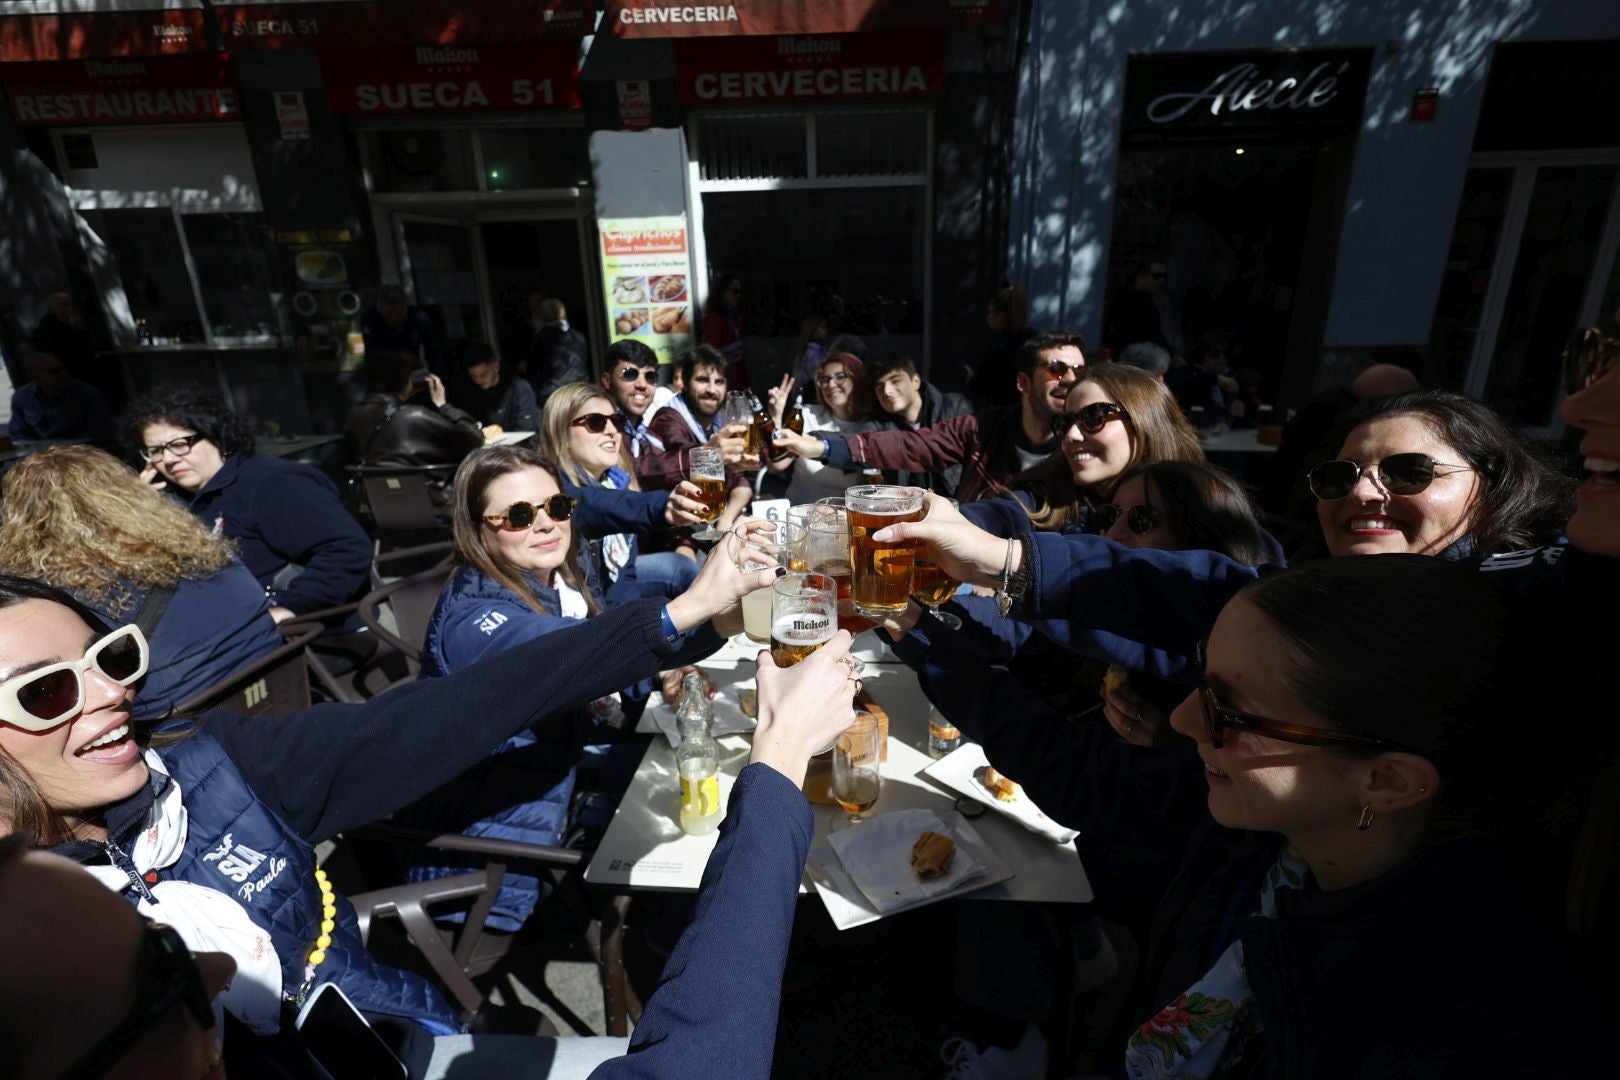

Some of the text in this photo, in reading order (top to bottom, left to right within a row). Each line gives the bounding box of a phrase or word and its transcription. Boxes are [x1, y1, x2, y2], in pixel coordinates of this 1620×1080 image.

[619, 5, 738, 25] CERVECERIA
[232, 19, 319, 37] SUECA 51
[415, 46, 480, 66] Mahou
[777, 37, 844, 55] Mahou
[694, 65, 928, 99] CERVECERIA
[15, 87, 237, 121] RESTAURANTE
[355, 78, 556, 111] SUECA 51
[766, 506, 779, 521] 6
[793, 619, 830, 630] Mahou
[218, 844, 267, 882] SLA
[238, 857, 286, 902] Paula
